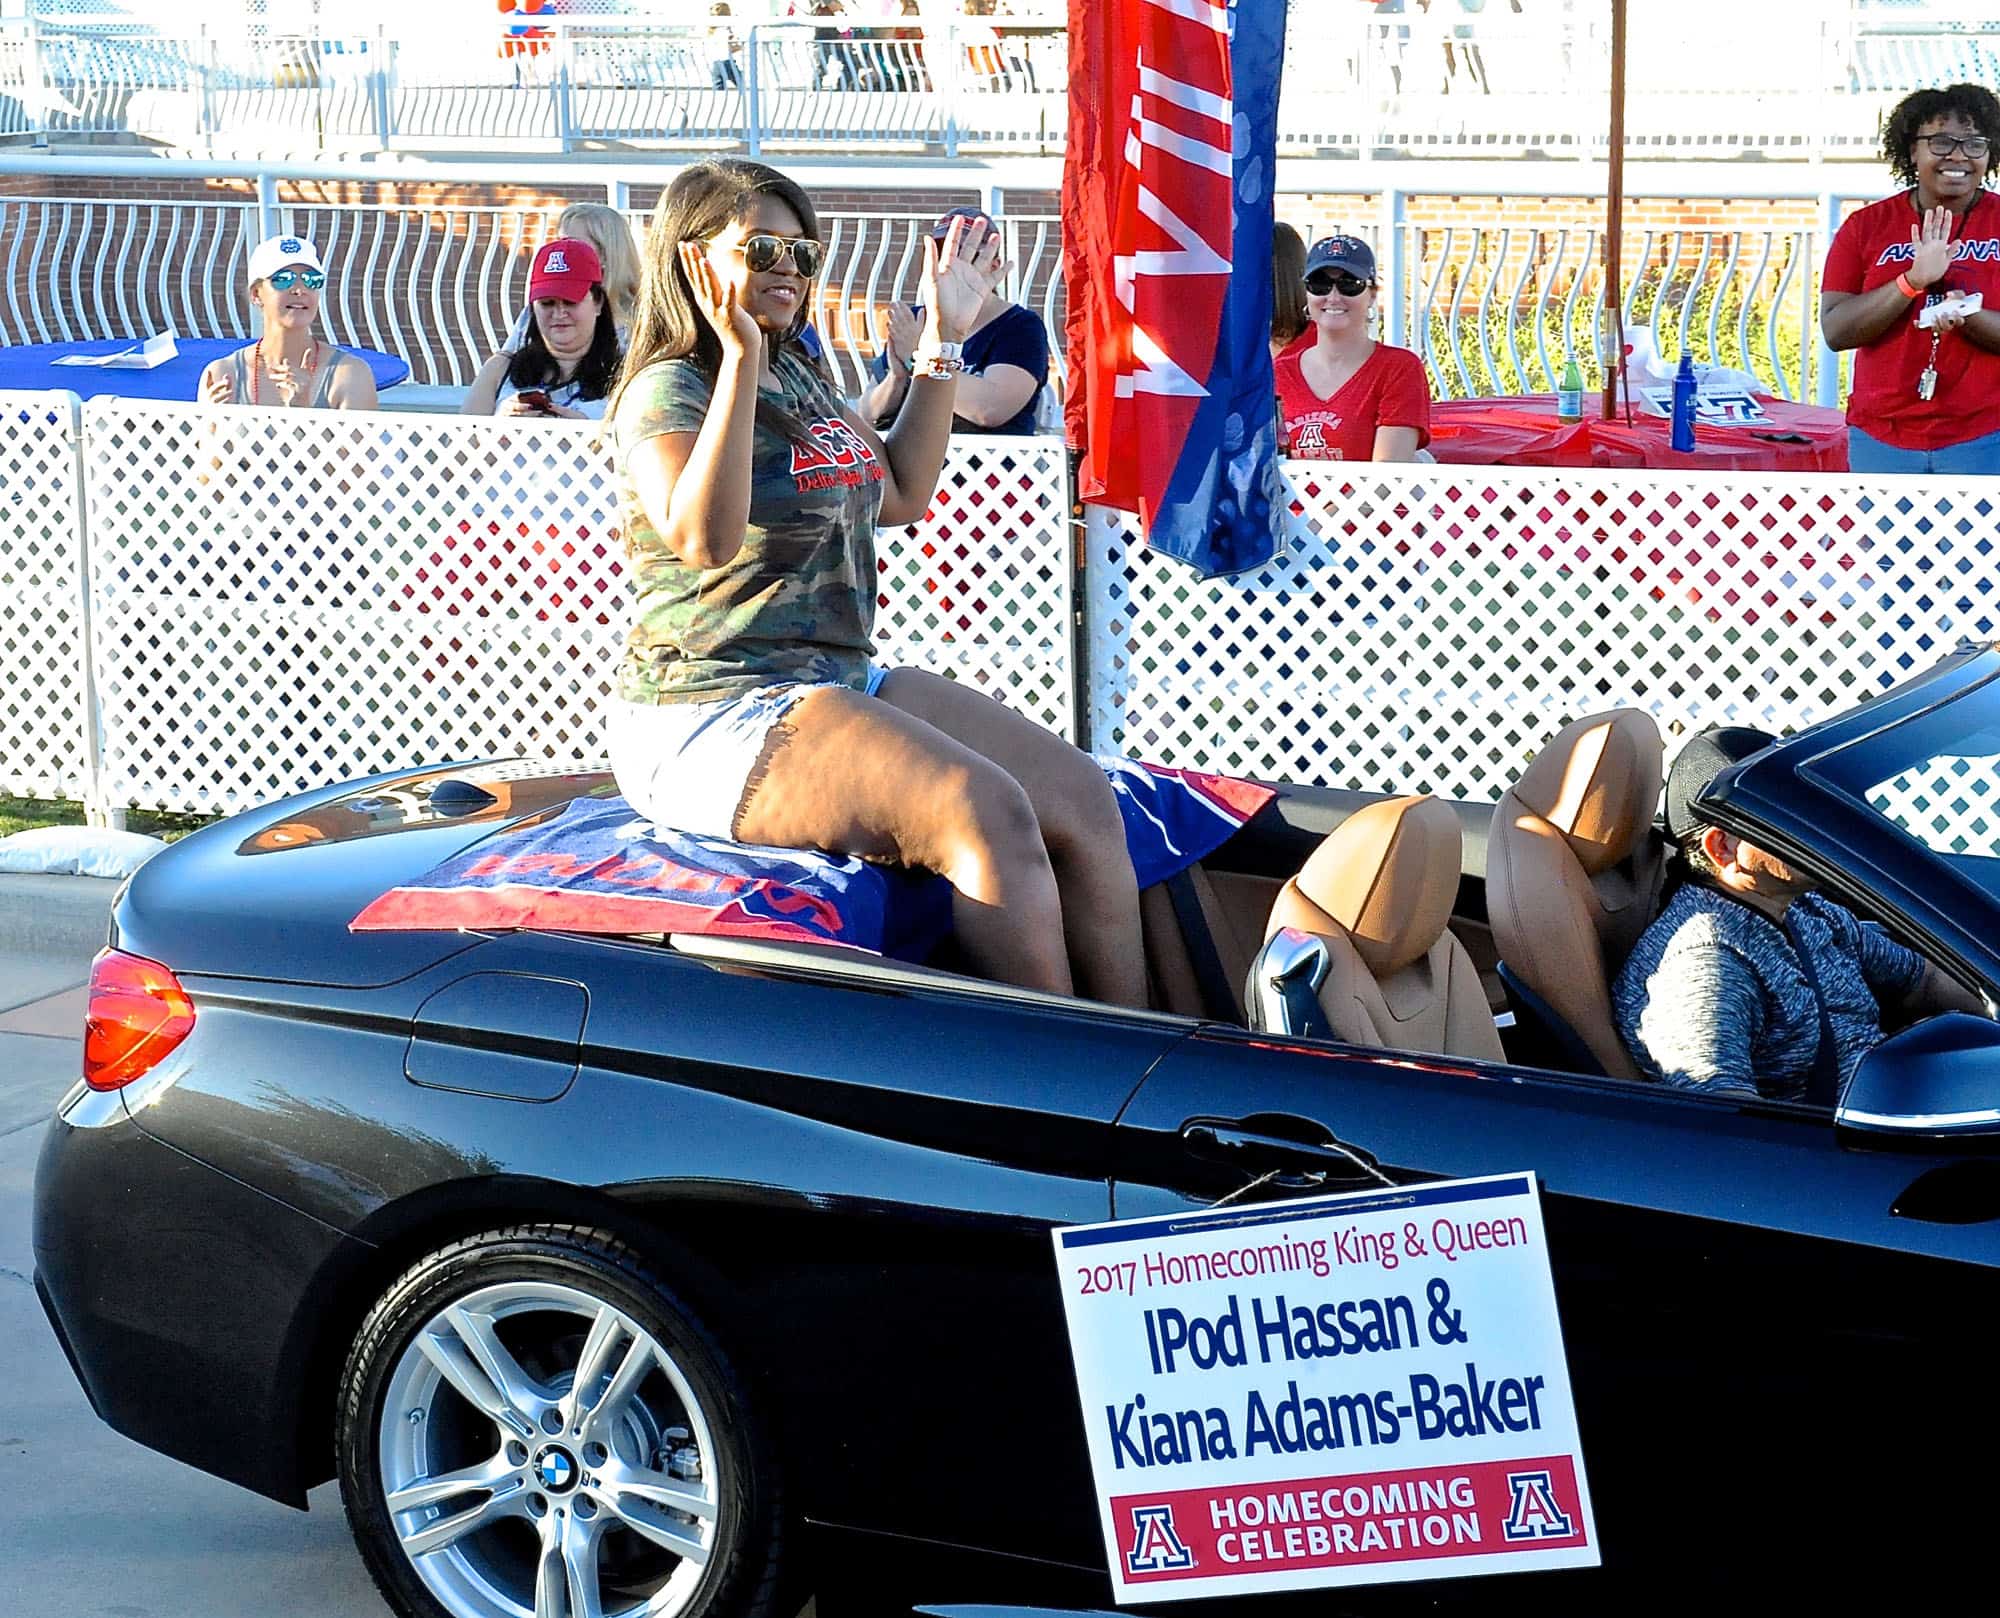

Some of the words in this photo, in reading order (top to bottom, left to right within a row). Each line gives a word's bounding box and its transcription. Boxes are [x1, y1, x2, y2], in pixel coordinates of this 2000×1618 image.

[544, 251, 570, 273] A
[1296, 422, 1328, 449] A
[796, 470, 836, 495] Delta
[1078, 1262, 1137, 1296] 2017
[1144, 1234, 1329, 1287] Homecoming
[1334, 1226, 1399, 1269] King
[1404, 1224, 1428, 1257] &
[1432, 1216, 1527, 1261] Queen
[1144, 1295, 1248, 1374] IPod
[1252, 1291, 1419, 1364] Hassan
[1426, 1277, 1468, 1345] &
[1106, 1393, 1237, 1469] Kiana
[1245, 1362, 1545, 1457] Adams-Baker
[1210, 1477, 1476, 1529] HOMECOMING
[1501, 1470, 1573, 1542] A
[1126, 1504, 1195, 1573] A
[1216, 1511, 1482, 1565] CELEBRATION
